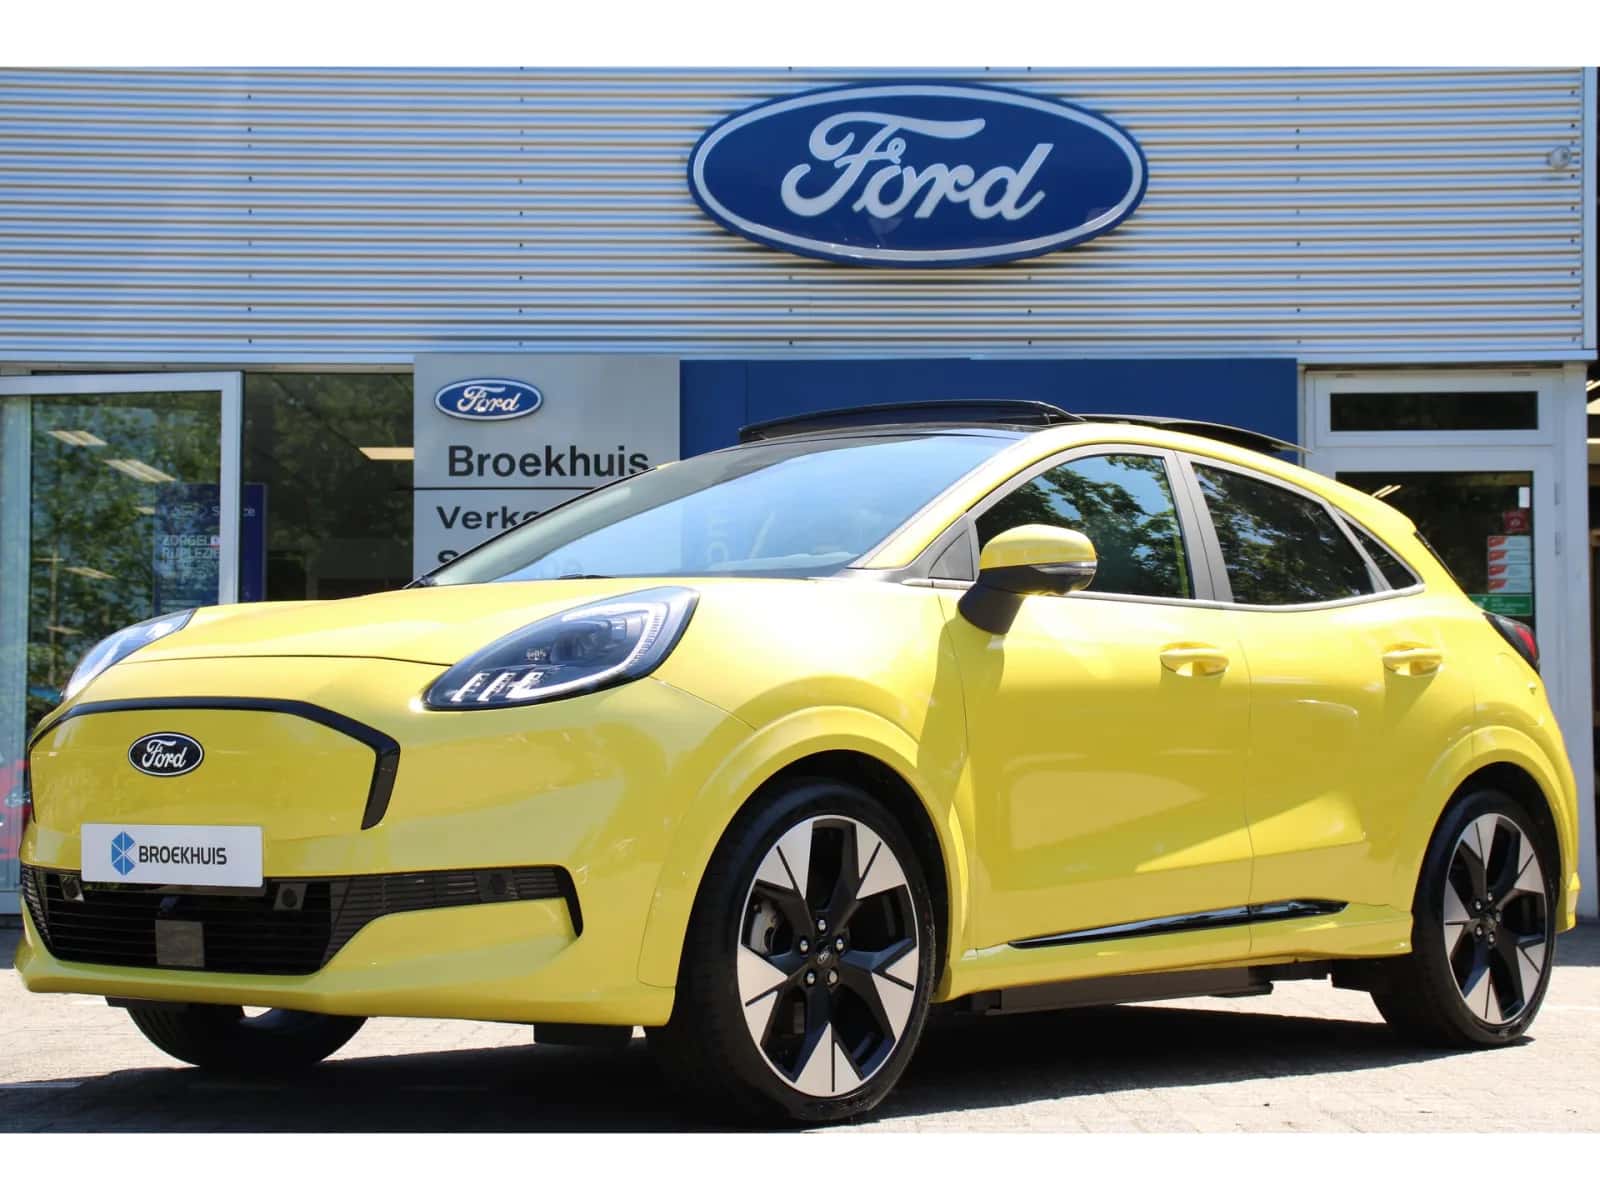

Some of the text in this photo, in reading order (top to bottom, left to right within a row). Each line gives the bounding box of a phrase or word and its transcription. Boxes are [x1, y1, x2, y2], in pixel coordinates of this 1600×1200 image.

[781, 111, 1054, 221] Ford
[456, 384, 521, 412] Ford
[448, 445, 649, 477] Broekhuis
[142, 739, 187, 768] Ford
[138, 845, 227, 865] BROEKHUIS
